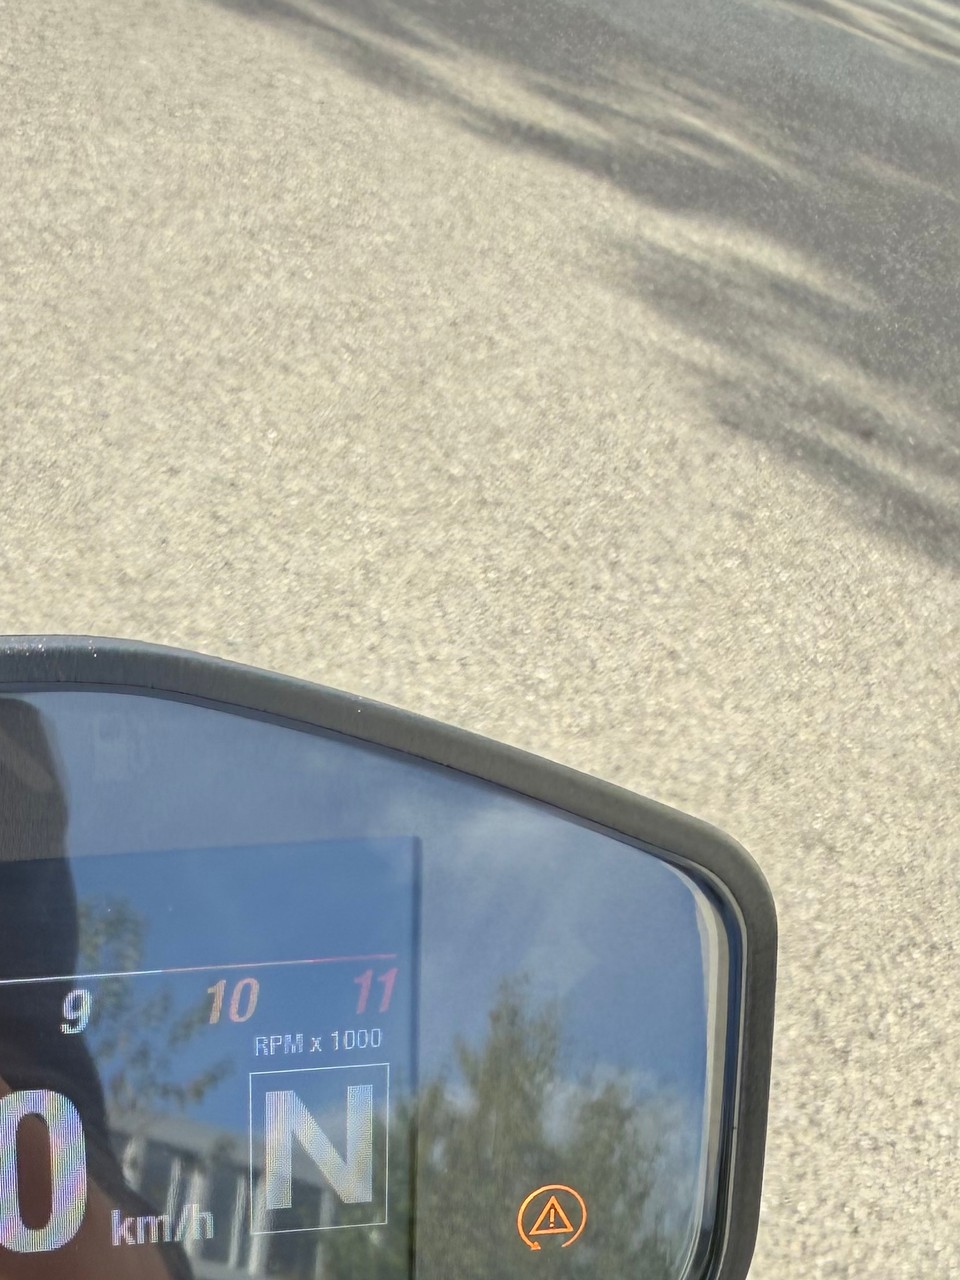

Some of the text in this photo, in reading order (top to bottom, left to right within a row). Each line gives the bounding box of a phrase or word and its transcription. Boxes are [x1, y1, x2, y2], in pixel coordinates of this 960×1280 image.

[62, 989, 92, 1034] 9
[207, 978, 259, 1024] 10
[353, 968, 398, 1014] 11
[254, 1028, 382, 1056] RPM x 1000
[265, 1084, 373, 1210] N
[111, 1204, 213, 1246] km/h
